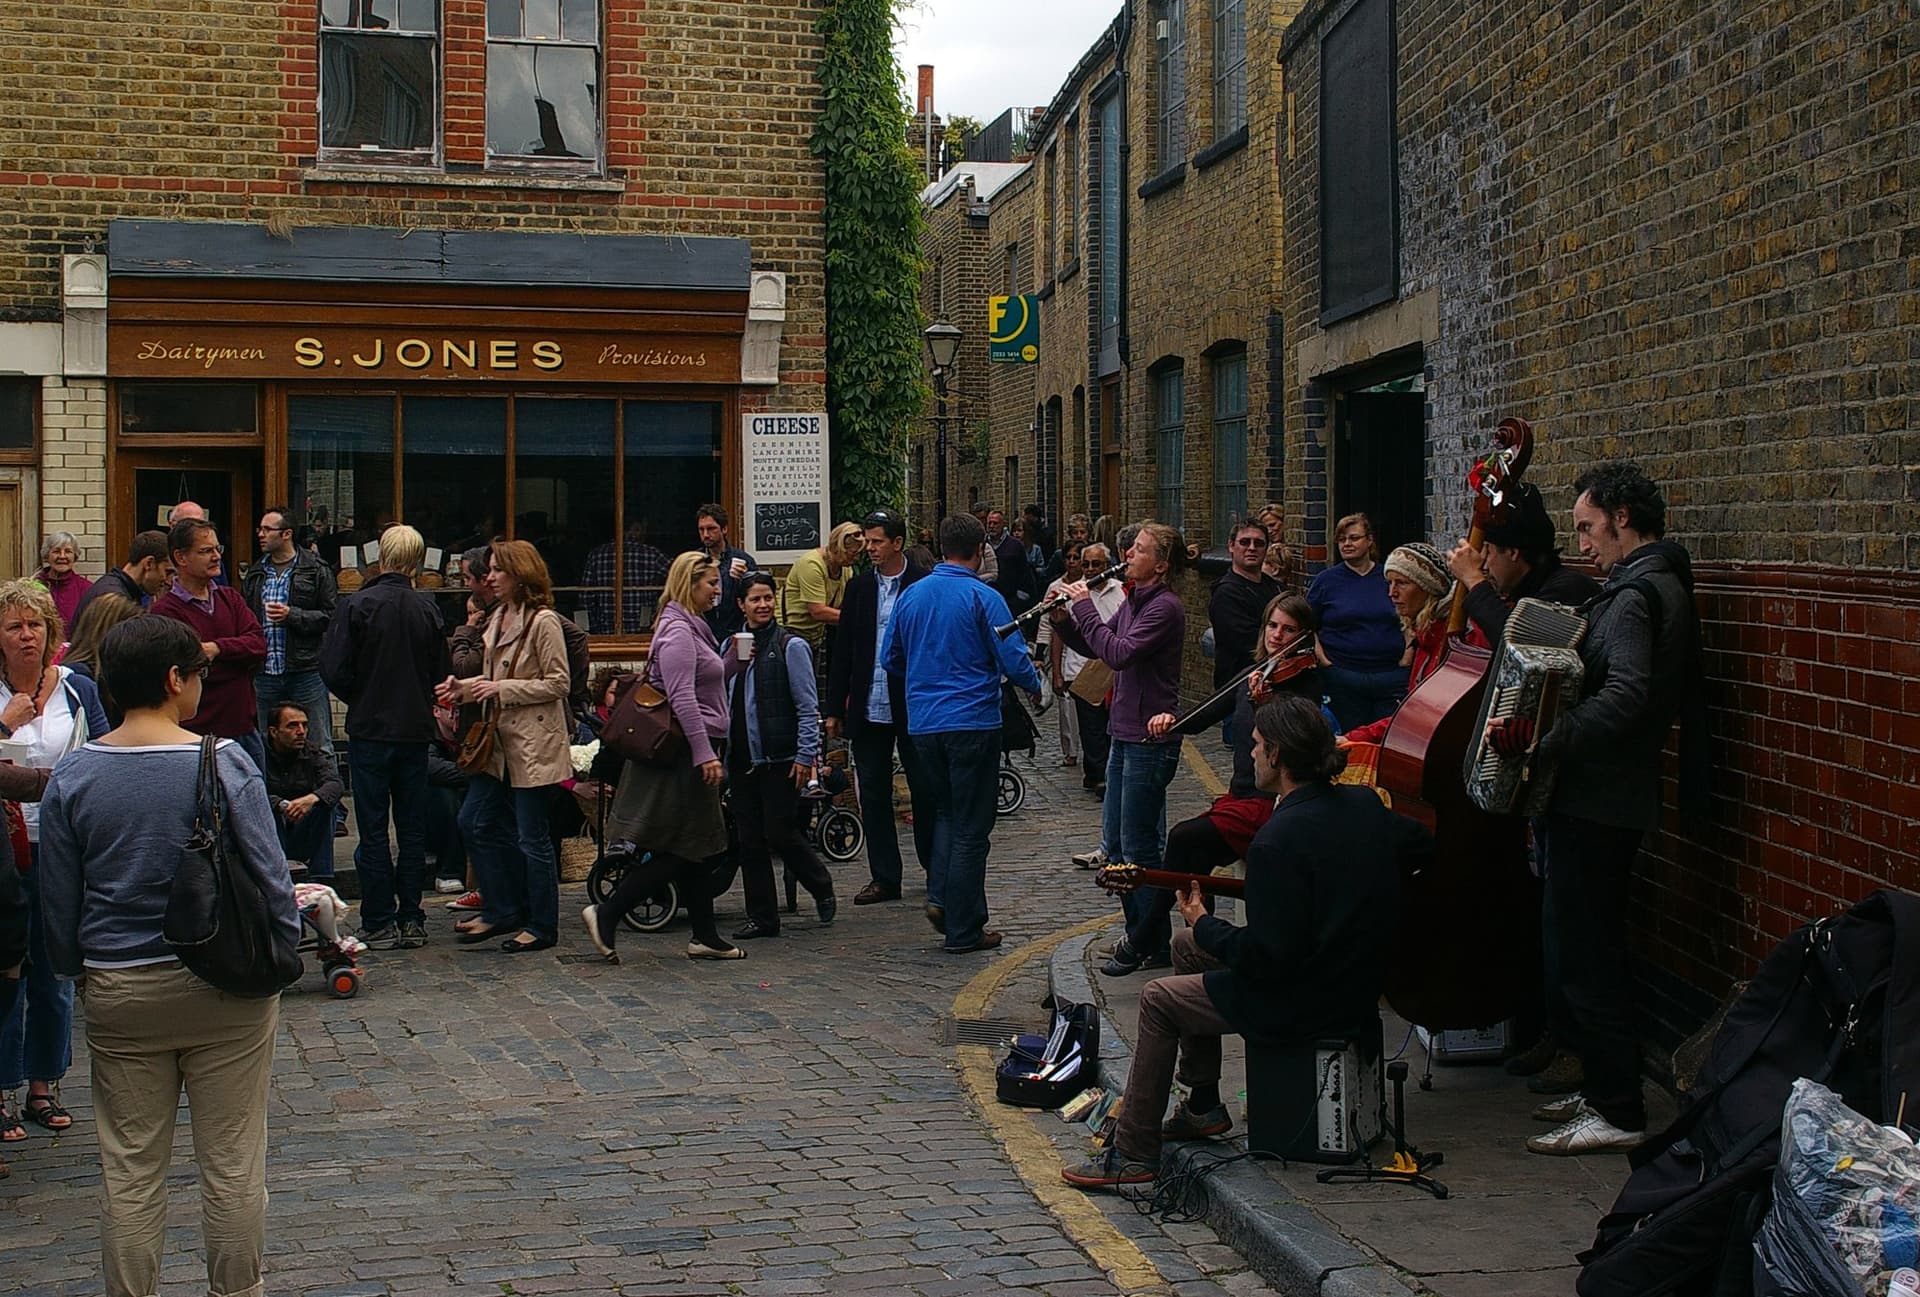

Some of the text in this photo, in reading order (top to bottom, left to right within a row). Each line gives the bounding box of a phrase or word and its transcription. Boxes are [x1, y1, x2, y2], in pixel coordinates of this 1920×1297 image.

[137, 340, 266, 369] Dairymen
[597, 344, 707, 367] Provisions
[752, 417, 819, 435] CHEESE
[768, 504, 805, 516] SHOP
